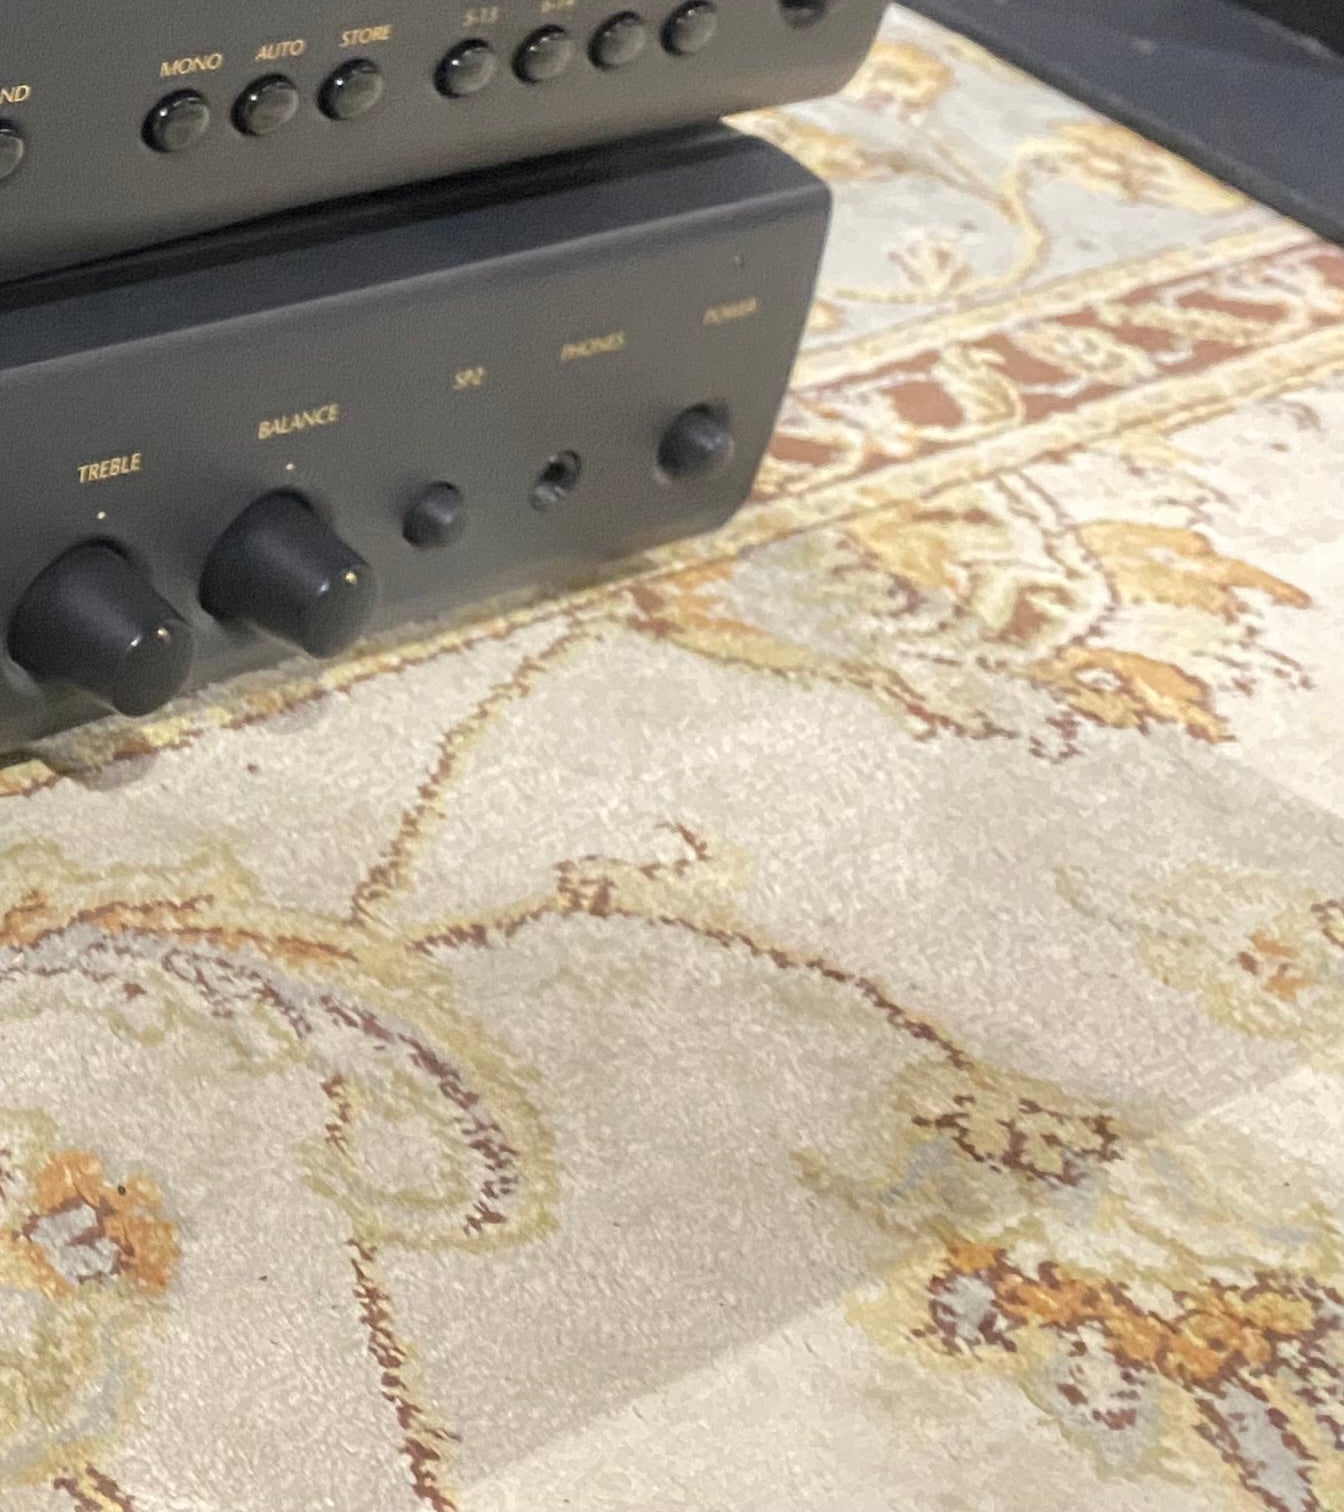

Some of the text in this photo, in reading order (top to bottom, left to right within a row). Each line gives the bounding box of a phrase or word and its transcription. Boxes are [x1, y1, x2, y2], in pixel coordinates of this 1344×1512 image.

[338, 24, 393, 48] STORE
[255, 38, 306, 62] AUTO
[159, 52, 224, 78] MONO
[256, 402, 341, 440] BALANCE
[76, 451, 143, 485] TREBLE
